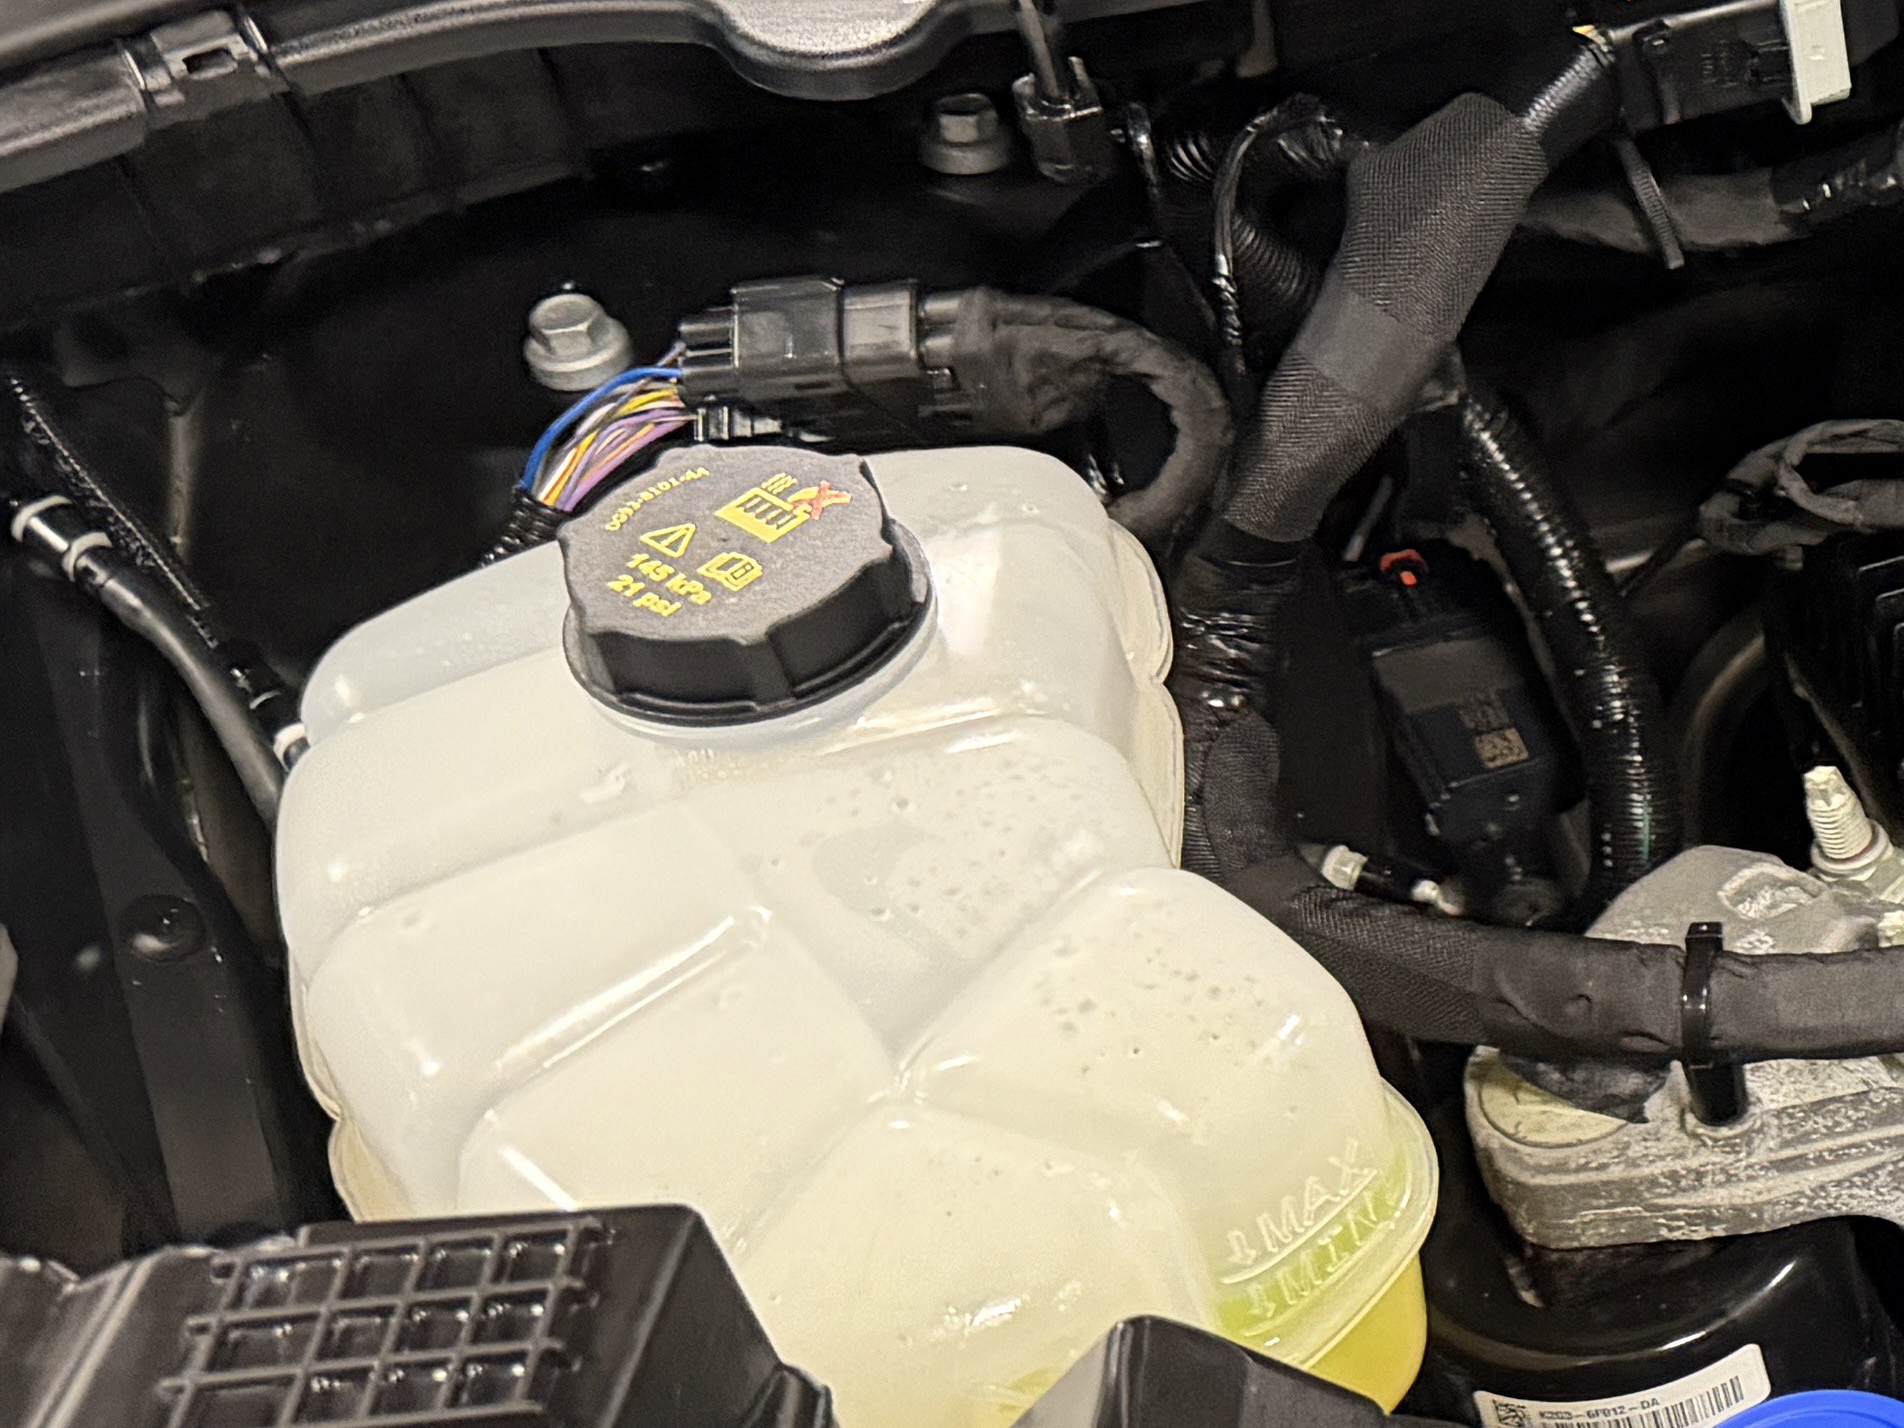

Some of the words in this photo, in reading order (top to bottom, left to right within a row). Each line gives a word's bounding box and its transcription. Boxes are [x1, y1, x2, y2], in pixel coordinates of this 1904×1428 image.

[606, 574, 646, 597] 21
[632, 592, 682, 617] psi
[626, 553, 675, 581] 145
[665, 573, 712, 606] kPa
[1261, 1138, 1383, 1254] MAX
